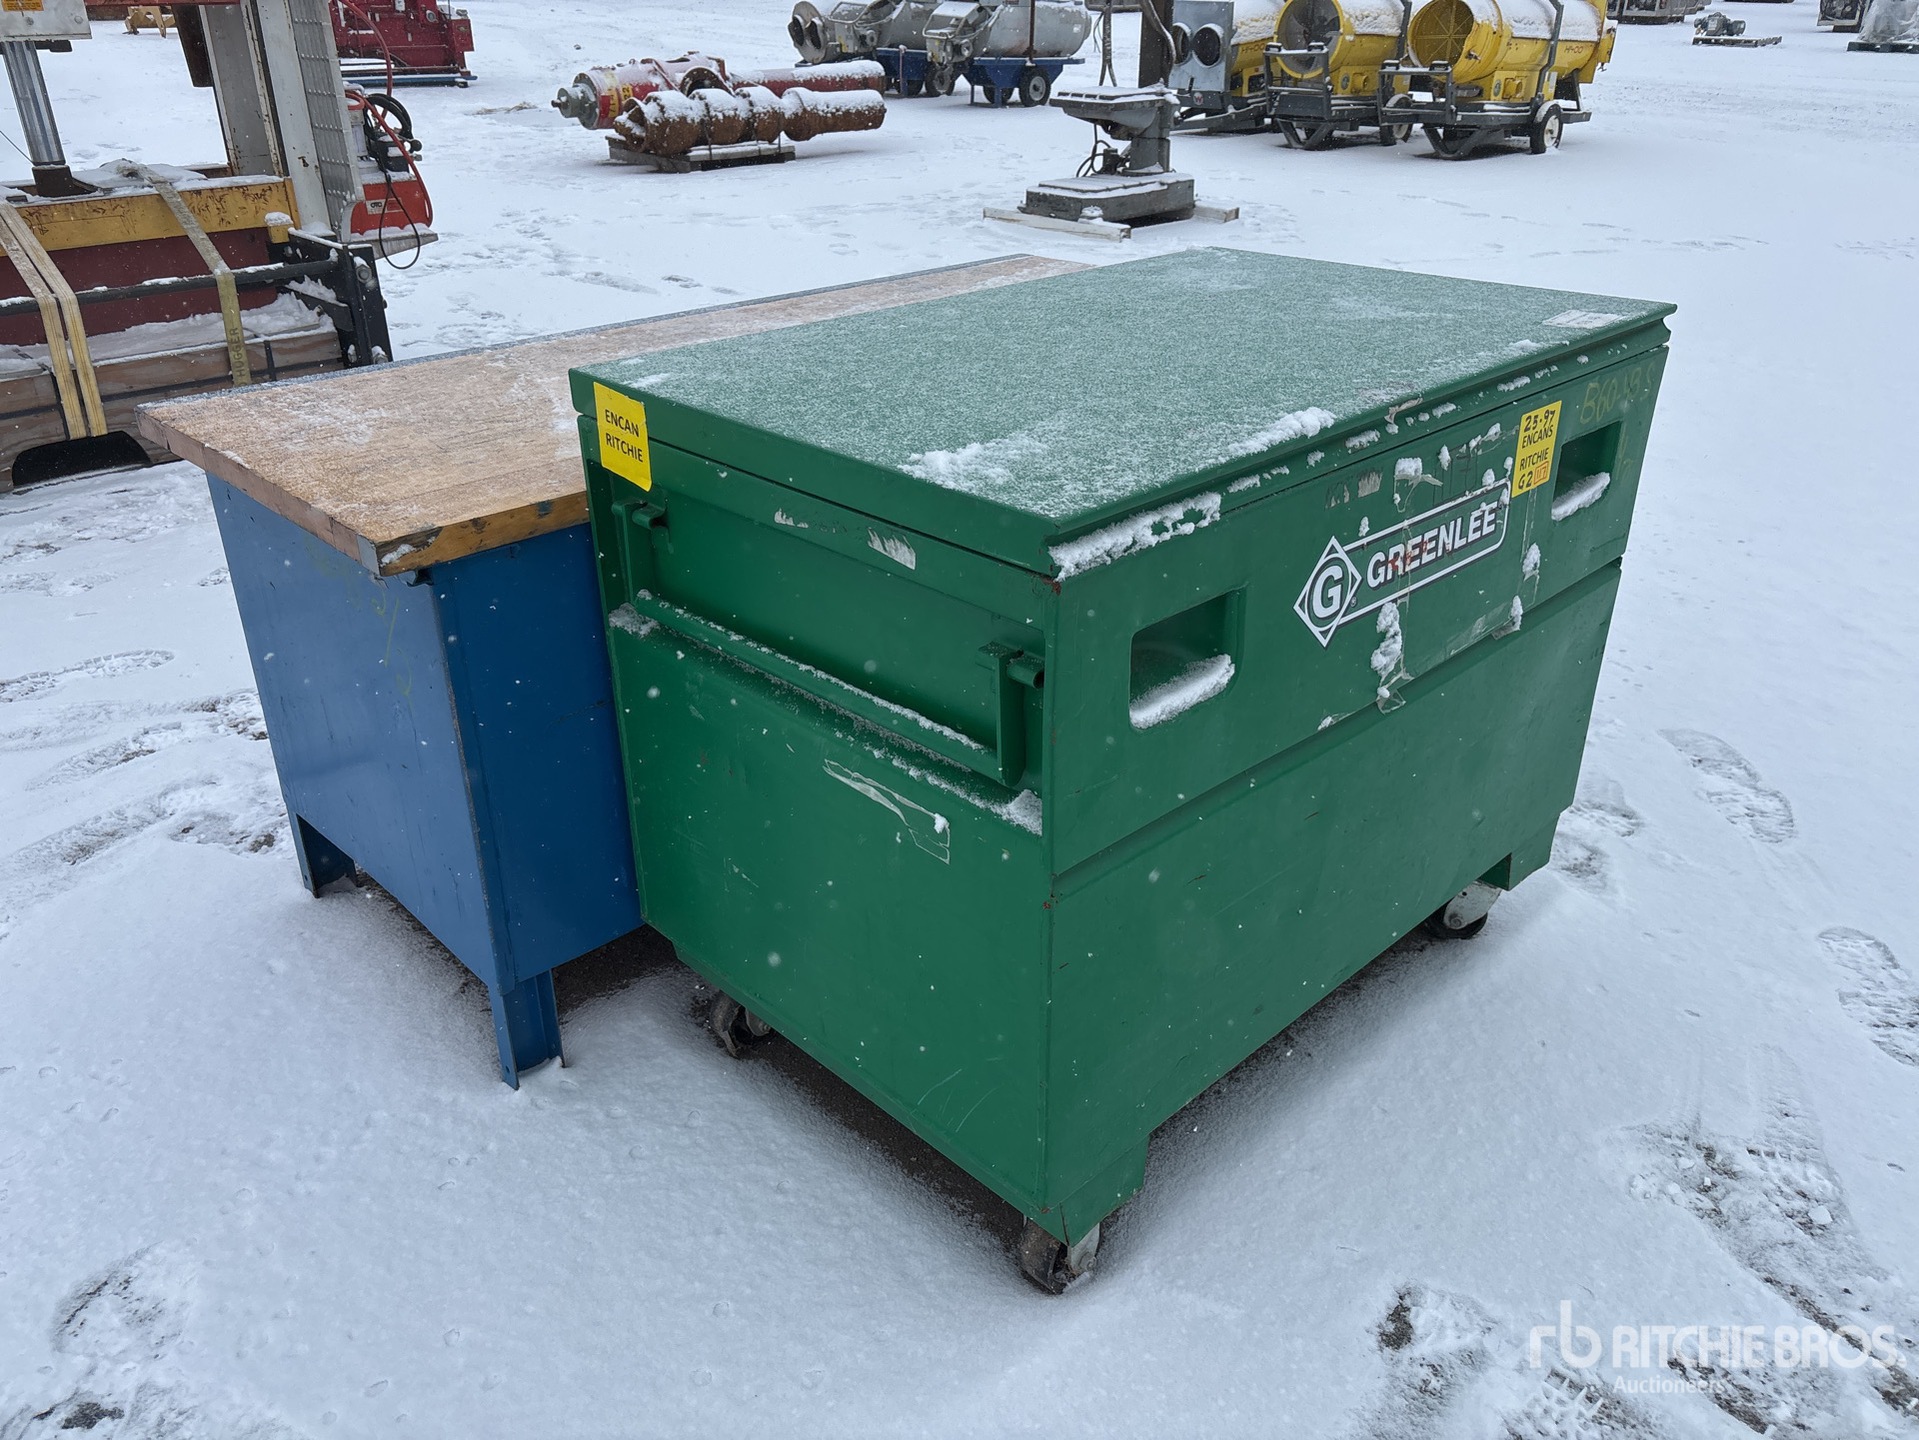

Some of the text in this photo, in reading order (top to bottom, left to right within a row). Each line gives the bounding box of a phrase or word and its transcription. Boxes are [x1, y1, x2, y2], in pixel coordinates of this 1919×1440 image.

[229, 327, 246, 377] HUGGER
[604, 408, 640, 438] ENCAN
[1521, 425, 1554, 449] ENCANS
[605, 432, 643, 462] RITCHIE
[1519, 447, 1550, 472] RITCHIE
[1366, 501, 1498, 589] GREENLEE
